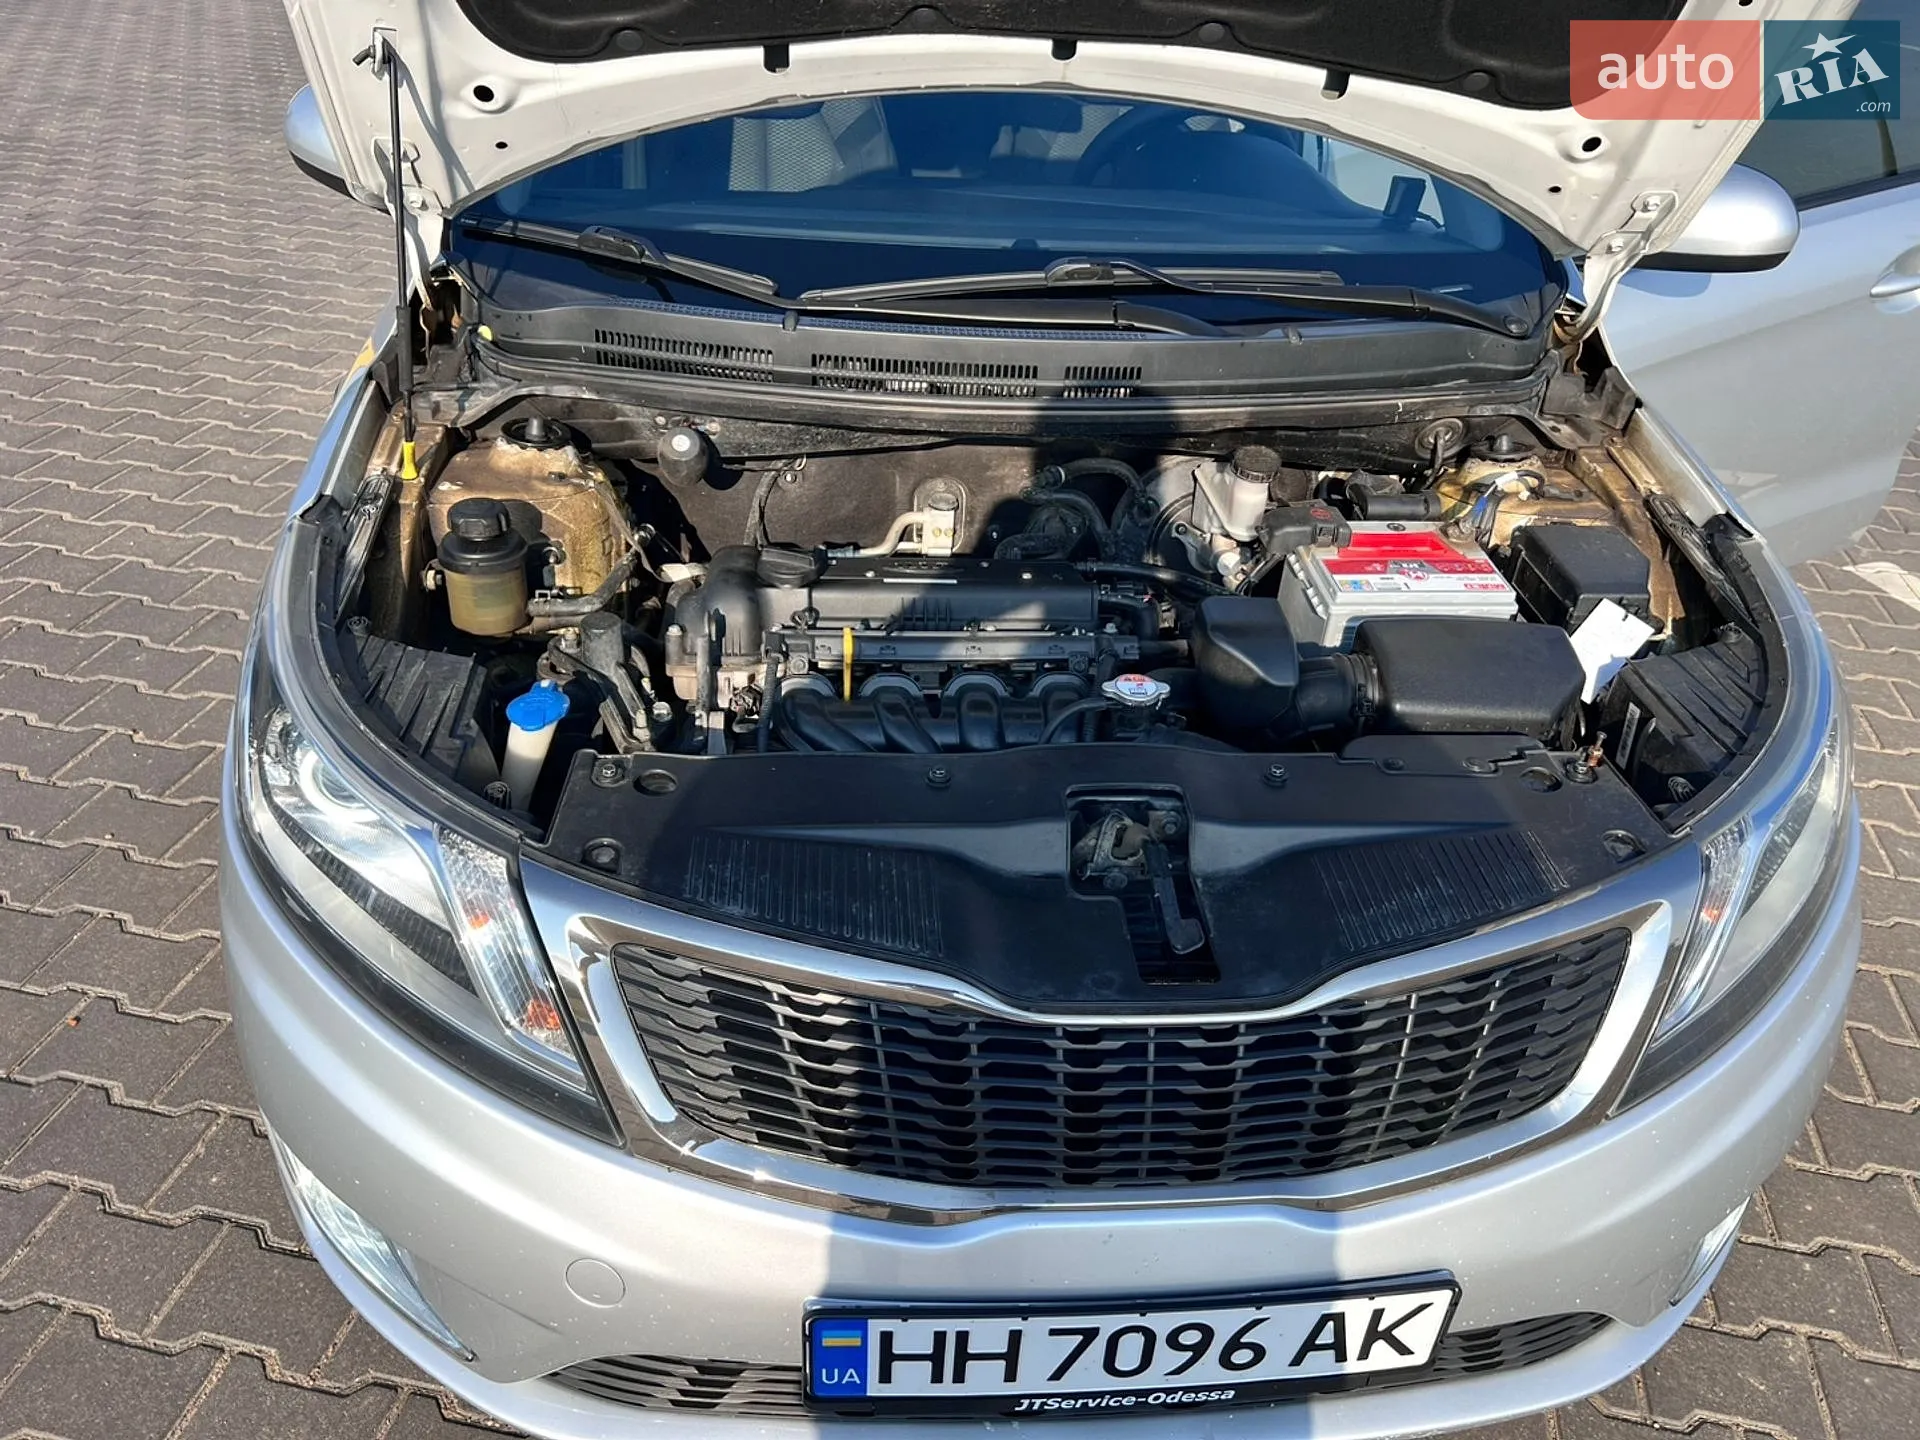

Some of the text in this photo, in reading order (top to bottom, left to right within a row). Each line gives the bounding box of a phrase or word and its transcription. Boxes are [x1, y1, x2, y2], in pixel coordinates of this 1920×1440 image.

[877, 1303, 1435, 1385] HH 7096 AK
[821, 1367, 861, 1385] UA
[1013, 1387, 1236, 1413] JTService-Odessa
